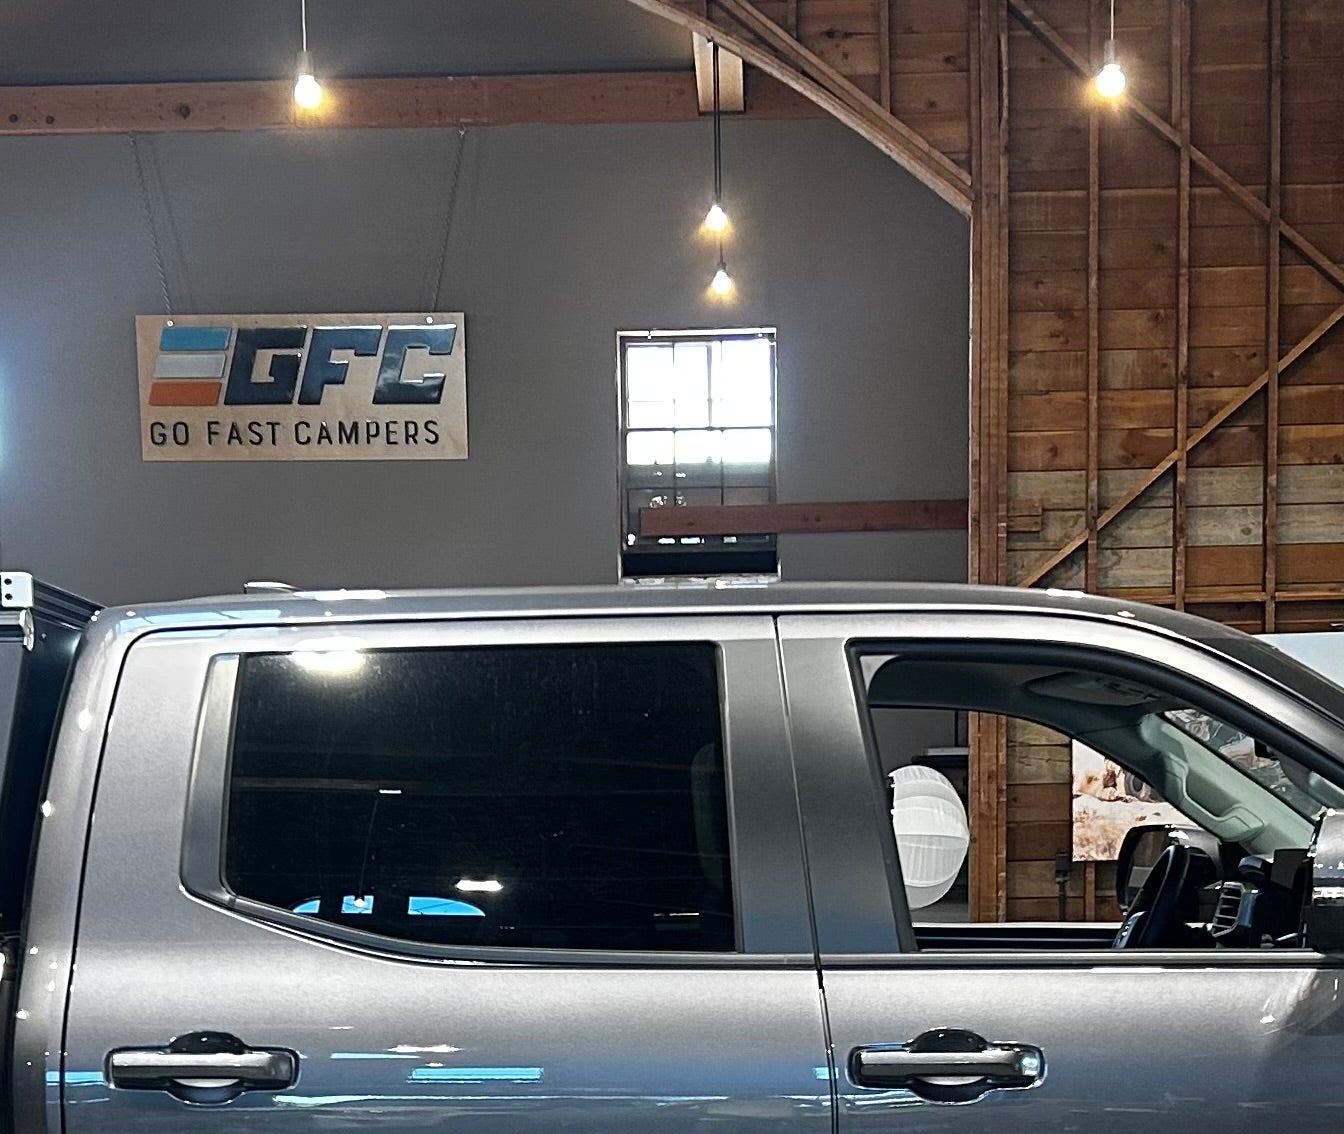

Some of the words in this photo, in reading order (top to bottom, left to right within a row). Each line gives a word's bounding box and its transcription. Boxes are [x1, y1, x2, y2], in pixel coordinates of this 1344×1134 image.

[223, 323, 457, 405] GFC
[150, 422, 190, 447] GO
[208, 421, 280, 446] FAST
[294, 419, 440, 446] CAMPERS
